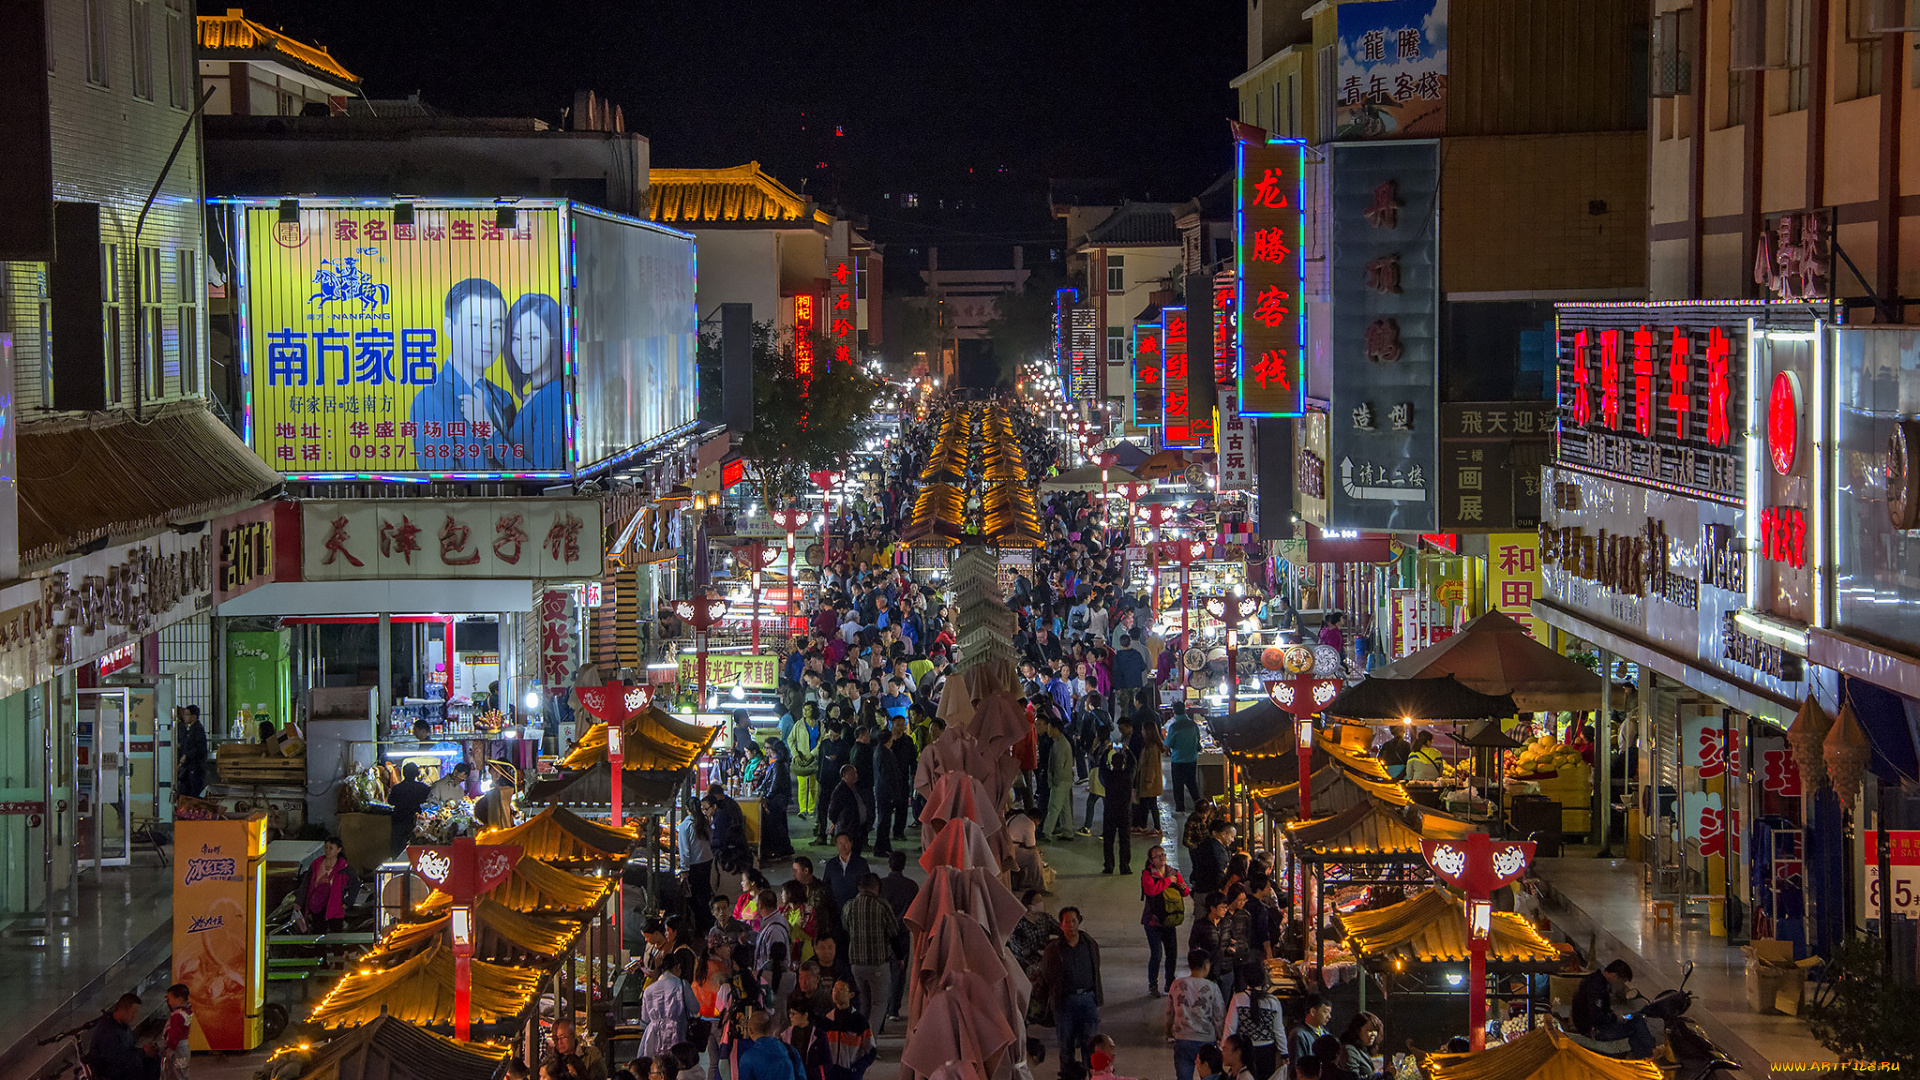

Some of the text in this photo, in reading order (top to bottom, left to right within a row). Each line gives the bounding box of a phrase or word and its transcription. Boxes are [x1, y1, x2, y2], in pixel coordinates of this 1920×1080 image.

[1363, 29, 1420, 60] 龍騰
[1343, 71, 1441, 104] 青年客棧
[1252, 168, 1291, 391] 龙腾客栈
[832, 262, 853, 366] 奇石珍藏
[266, 327, 437, 387] 南方家居
[349, 420, 493, 439] 华盛商场四楼
[1352, 402, 1414, 432] 造型
[349, 443, 525, 460] 0937-8839176
[1358, 461, 1426, 487] 请上二楼
[1457, 467, 1483, 521] 画展
[322, 510, 584, 568] 天津包子馆
[185, 857, 236, 886] 冰红茶
